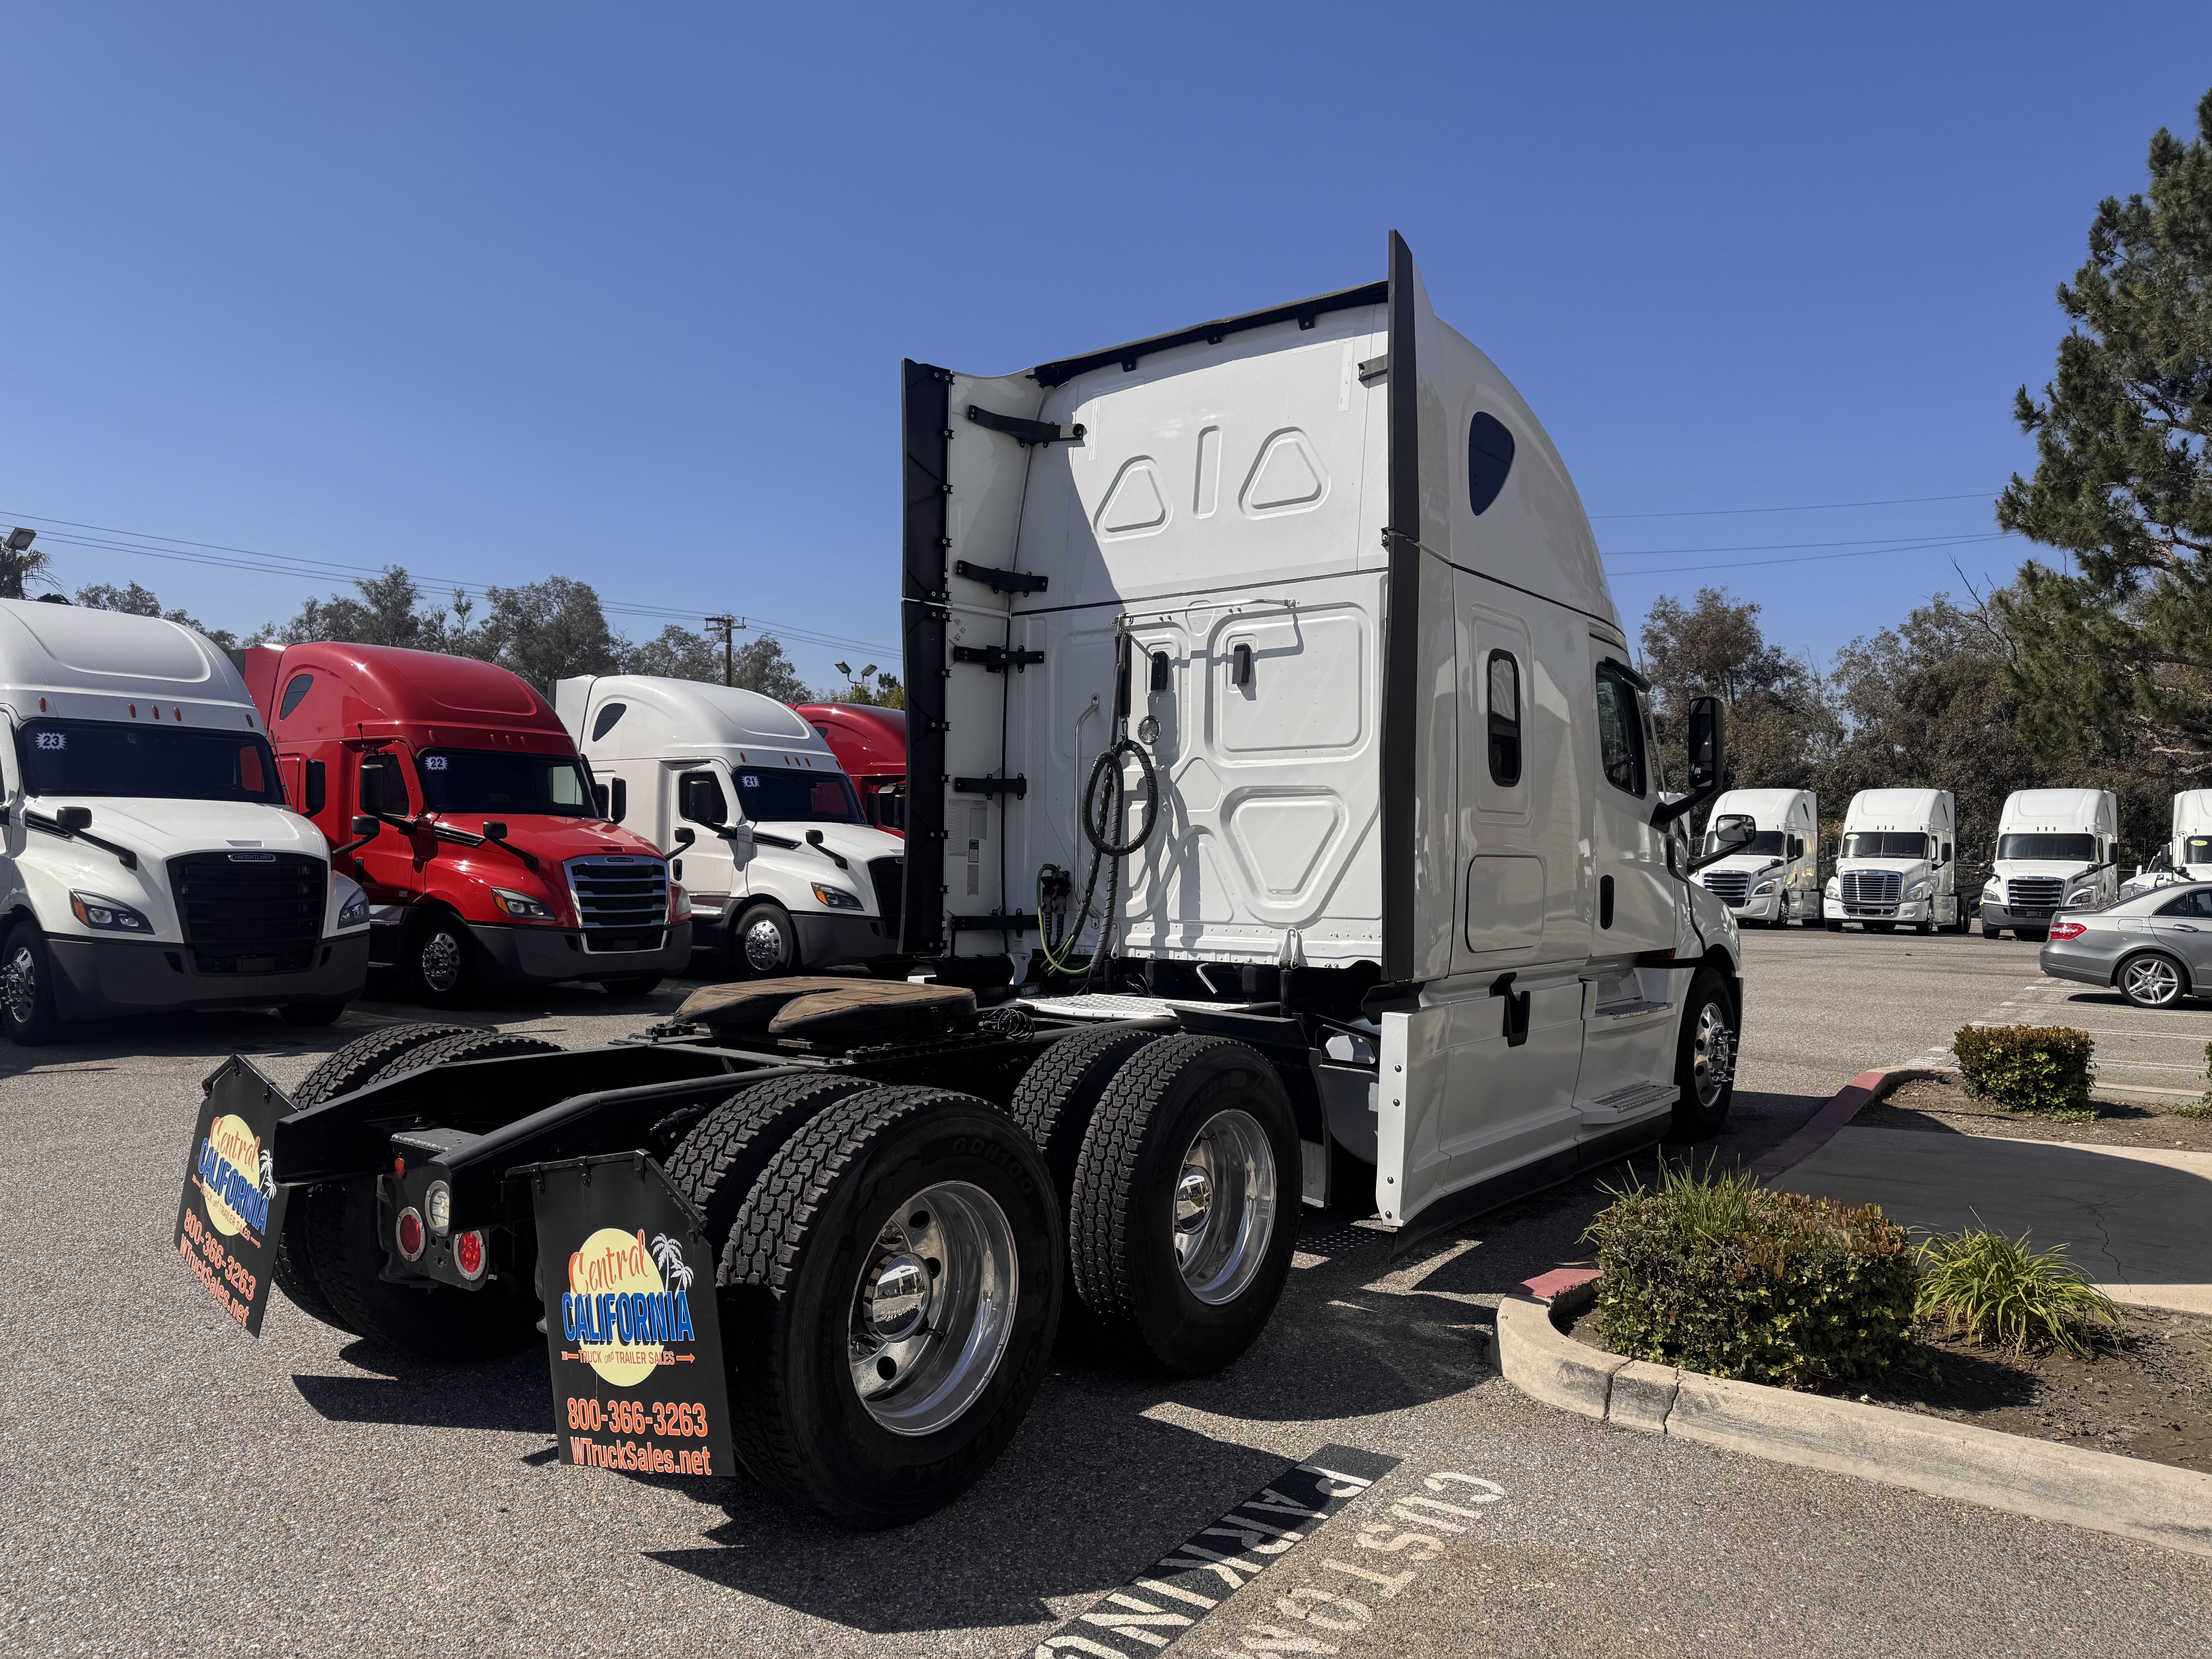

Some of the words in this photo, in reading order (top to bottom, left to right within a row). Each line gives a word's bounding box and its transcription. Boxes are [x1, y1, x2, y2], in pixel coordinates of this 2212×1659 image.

[43, 735, 59, 746] 23
[431, 759, 442, 767] 22
[210, 1117, 260, 1171] Central
[952, 1137, 1034, 1194] GDH100
[198, 1137, 269, 1235] CALIFORNIA
[201, 1183, 213, 1203] TRUCK
[219, 1203, 235, 1227] TRAILER
[236, 1221, 251, 1241] SALES
[180, 1233, 249, 1327] WTruckSales.net
[184, 1208, 256, 1301] 800-366-3263
[568, 1229, 649, 1297] Central
[562, 1290, 695, 1343] CALIFORNIA
[578, 1350, 602, 1363] TRUCK
[604, 1347, 615, 1364] and
[615, 1352, 646, 1364] TRAILER
[649, 1351, 675, 1365] SALES
[567, 1398, 708, 1437] 800-366-3263
[570, 1436, 712, 1475] WTruckSales.net
